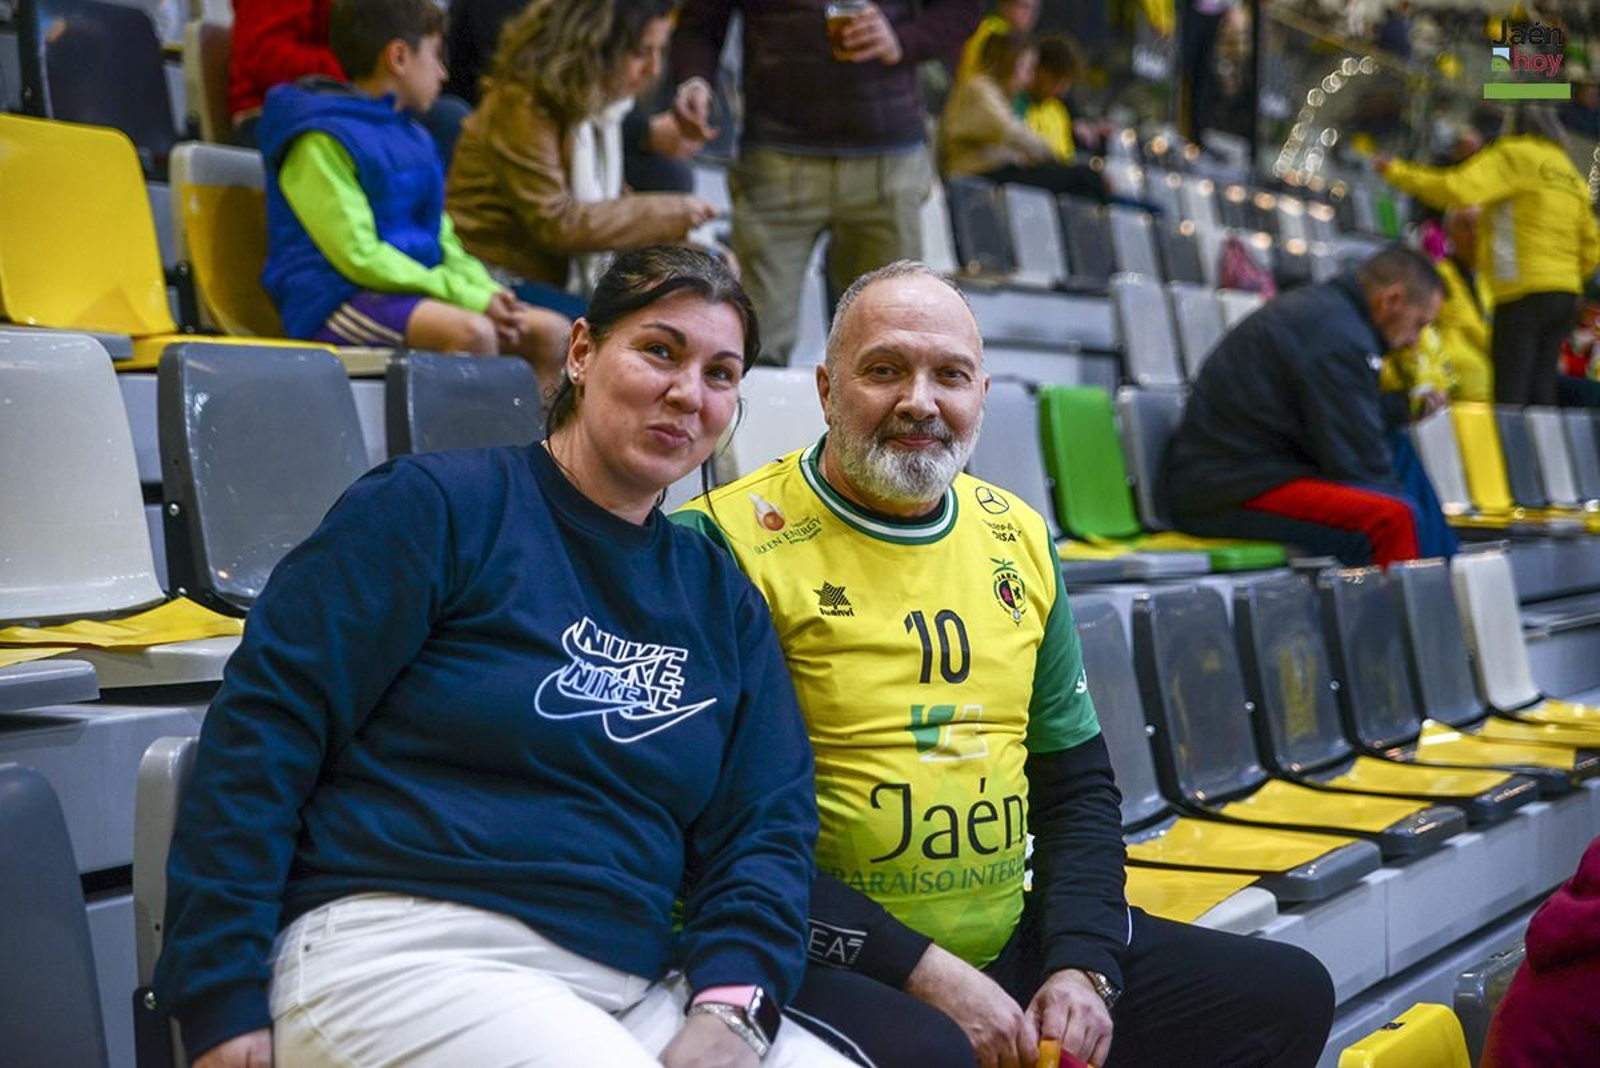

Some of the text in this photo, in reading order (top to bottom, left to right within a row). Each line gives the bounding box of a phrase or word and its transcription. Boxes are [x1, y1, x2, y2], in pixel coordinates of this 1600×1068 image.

[573, 616, 688, 690] NIKE
[904, 609, 970, 684] 10
[557, 656, 642, 703] NIKE
[870, 777, 1025, 863] Jaén
[961, 857, 1024, 889] INTER
[808, 927, 864, 964] EA7
